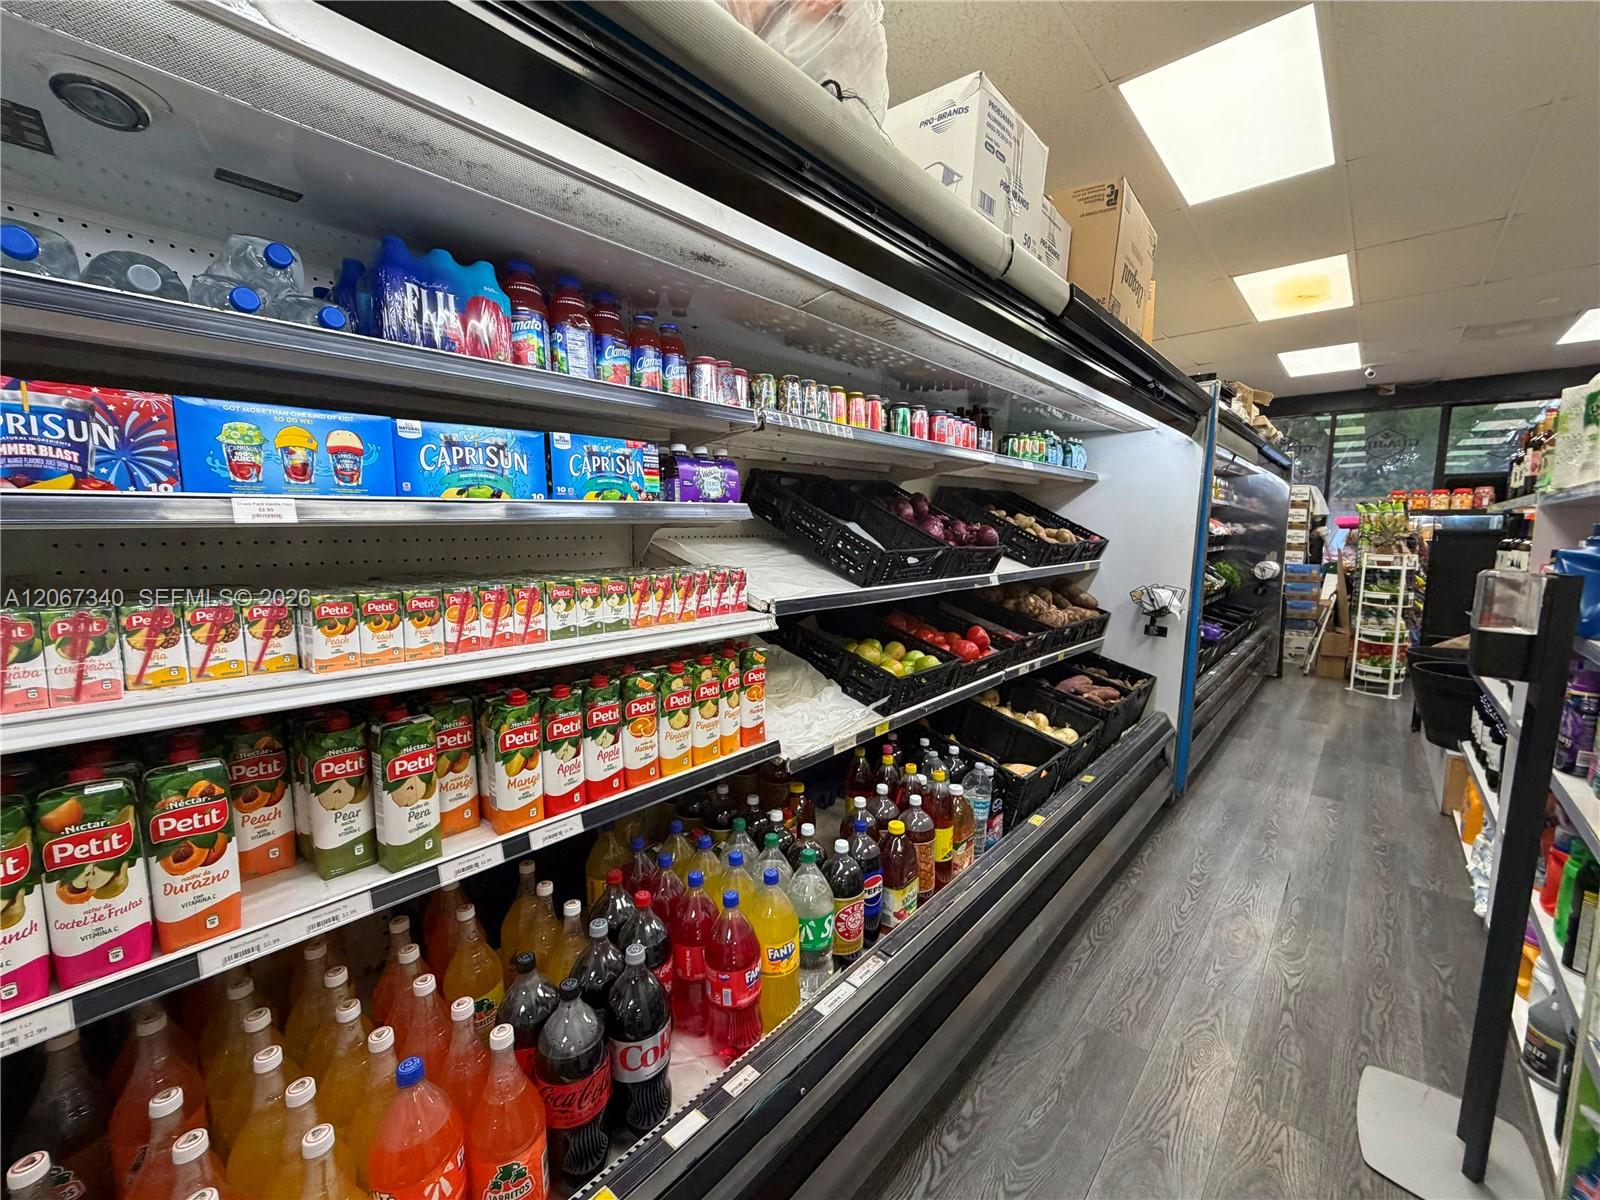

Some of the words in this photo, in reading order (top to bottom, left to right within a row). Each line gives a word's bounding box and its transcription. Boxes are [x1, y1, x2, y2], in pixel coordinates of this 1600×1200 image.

[919, 105, 970, 129] PRO-BRANDS
[1023, 232, 1032, 249] 50
[265, 408, 288, 416] THAN
[307, 412, 326, 420] KIND
[0, 411, 117, 451] RISUN
[29, 437, 71, 447] INGREDIENTS
[38, 444, 80, 465] BLAST
[419, 443, 528, 476] CAPRISUN
[321, 605, 351, 616] Petit
[368, 603, 394, 613] Petit
[412, 600, 436, 609] Petit
[324, 636, 350, 645] Peach
[371, 632, 394, 640] Peach
[592, 708, 619, 724] Petit
[695, 720, 720, 732] Pineapp
[436, 730, 472, 749] Petit
[505, 730, 539, 748] Petit
[664, 729, 691, 742] Pineapp
[596, 746, 620, 764] Apple
[232, 760, 281, 780] Petit
[320, 756, 366, 778] Petit
[394, 753, 435, 776] Petit
[557, 760, 581, 778] Apple
[440, 776, 474, 794] Mango
[506, 773, 540, 790] Mango
[158, 808, 222, 837] Petit
[241, 807, 282, 828] Peach
[334, 808, 362, 823] Pear
[408, 808, 432, 822] Pera
[250, 831, 271, 841] VITAMIN
[52, 833, 124, 864] Petit
[162, 868, 230, 897] Durazno
[180, 894, 212, 909] VITAMINA
[54, 912, 90, 931] Coctel
[108, 897, 143, 918] Frutas
[0, 919, 38, 946] unch
[745, 960, 761, 985] FAN
